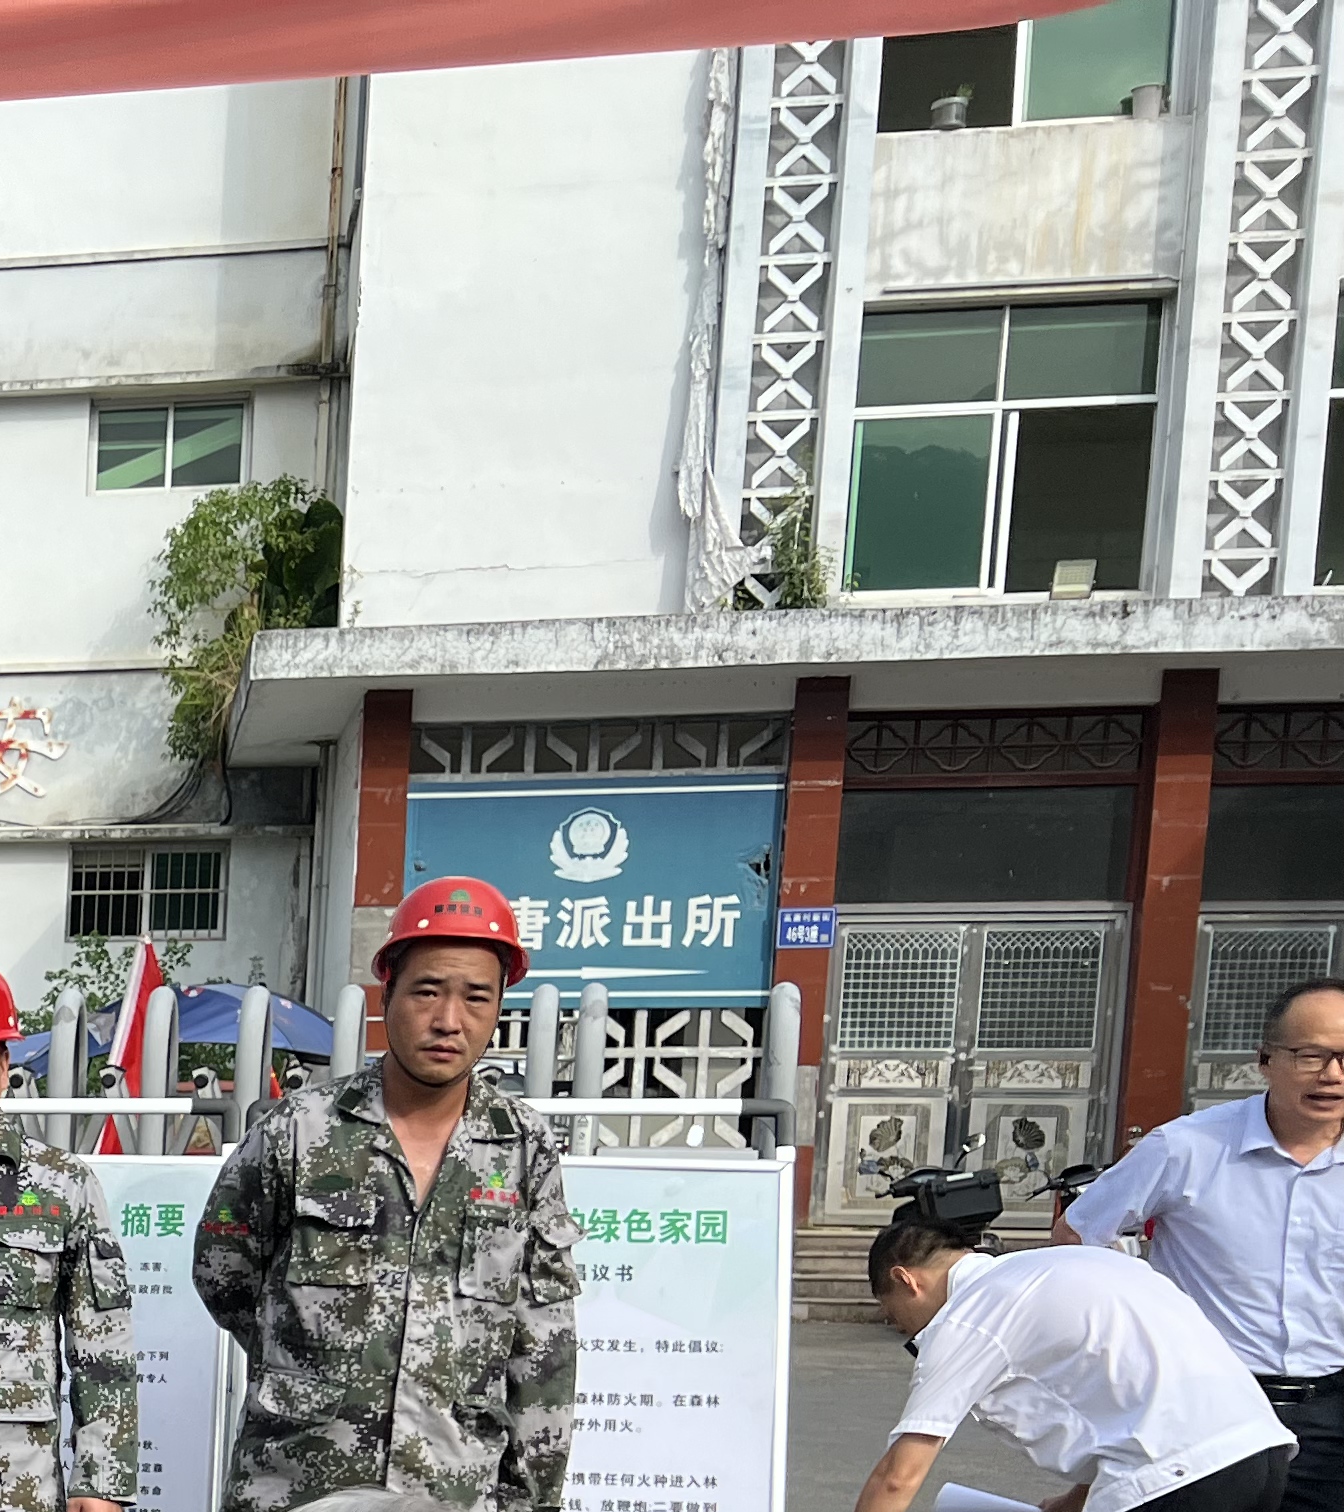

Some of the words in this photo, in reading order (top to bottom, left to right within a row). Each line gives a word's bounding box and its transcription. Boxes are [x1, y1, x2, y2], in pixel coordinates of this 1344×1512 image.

[509, 893, 742, 951] 唐派出所
[121, 1203, 185, 1237] 摘要
